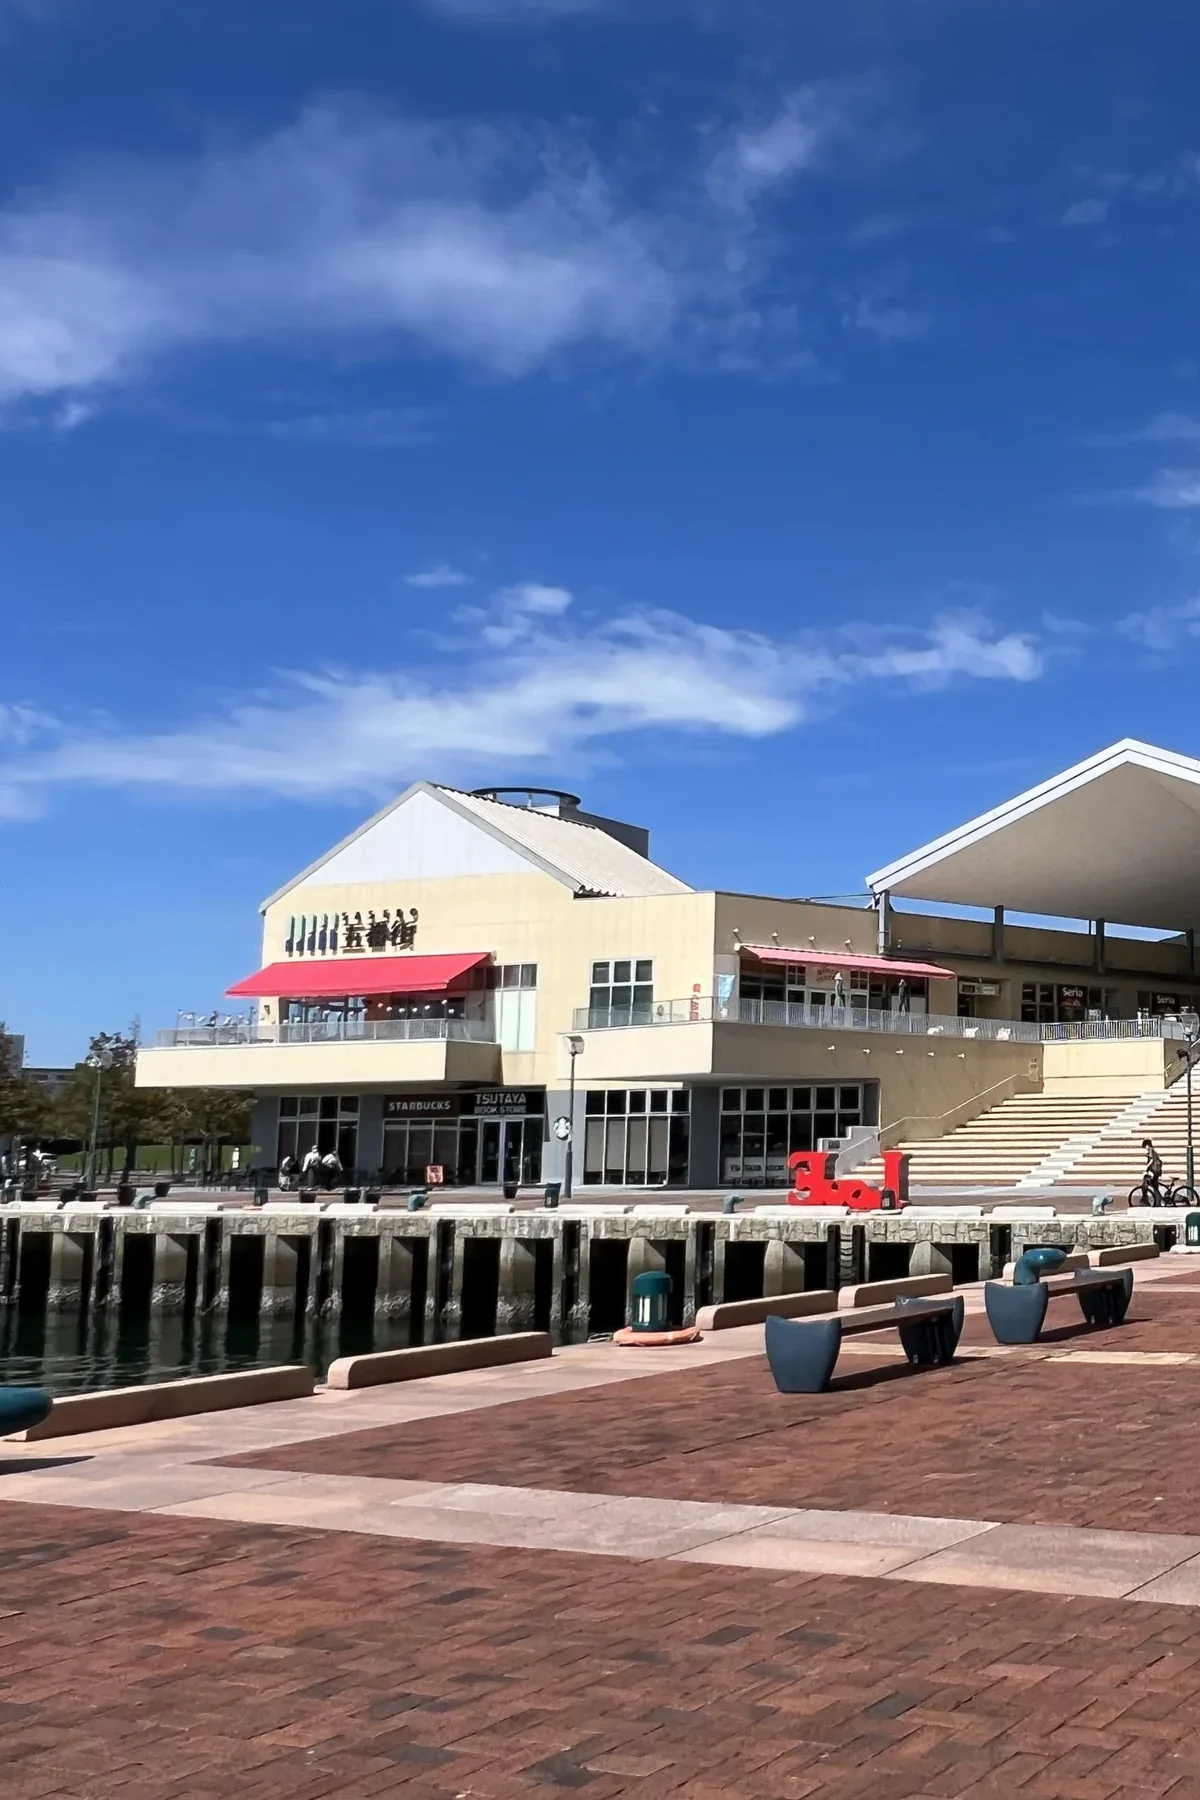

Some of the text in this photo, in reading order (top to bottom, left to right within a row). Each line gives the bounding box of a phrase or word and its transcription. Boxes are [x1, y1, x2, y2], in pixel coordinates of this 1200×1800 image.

[1062, 987, 1084, 997] Seria
[1156, 995, 1175, 1005] Seria
[474, 1093, 527, 1105] TSUTAYA
[388, 1100, 451, 1111] STARBUCKS
[474, 1105, 497, 1114] BOOK
